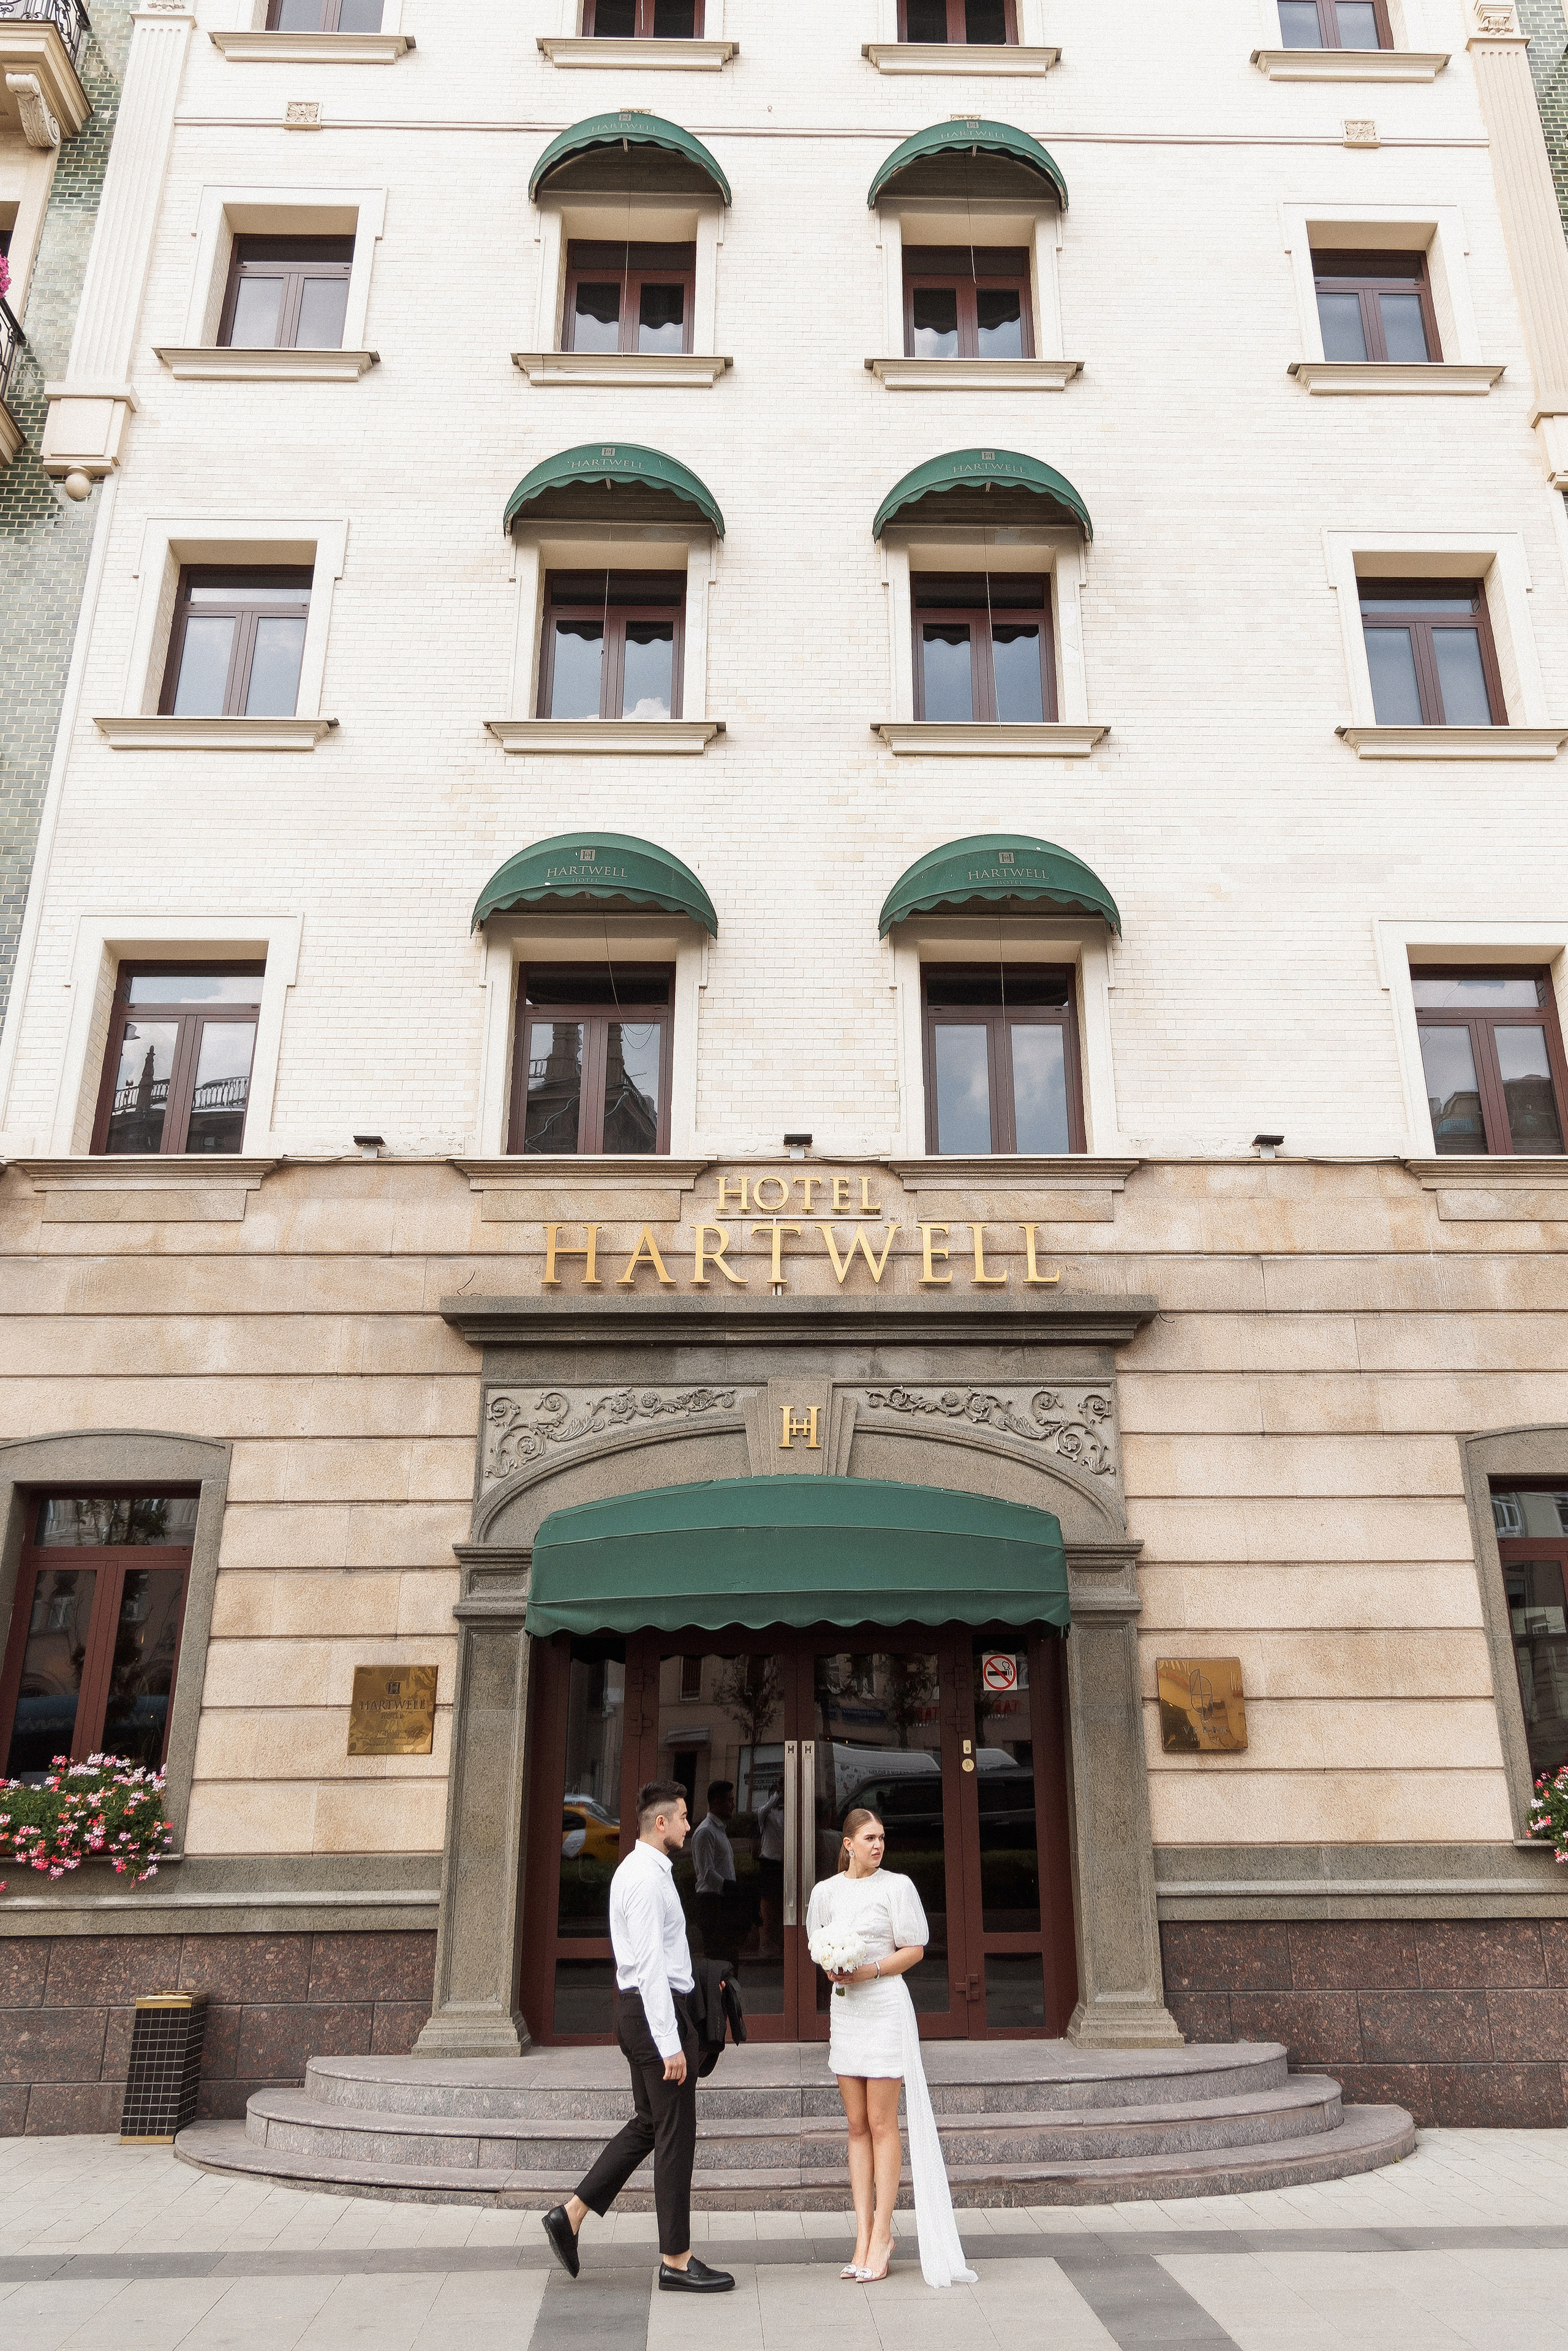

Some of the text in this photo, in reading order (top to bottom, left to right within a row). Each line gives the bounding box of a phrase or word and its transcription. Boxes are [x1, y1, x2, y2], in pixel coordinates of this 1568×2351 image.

[591, 123, 657, 132] HARTWELL
[571, 459, 645, 469] HARTWELL
[952, 463, 1027, 474] HARTWELL
[546, 866, 628, 878] HARTWELL
[968, 868, 1049, 880] HARTWELL
[715, 1176, 882, 1212] HOTEL
[540, 1223, 1061, 1285] HARTWELL
[360, 1699, 426, 1710] HARTWELL
